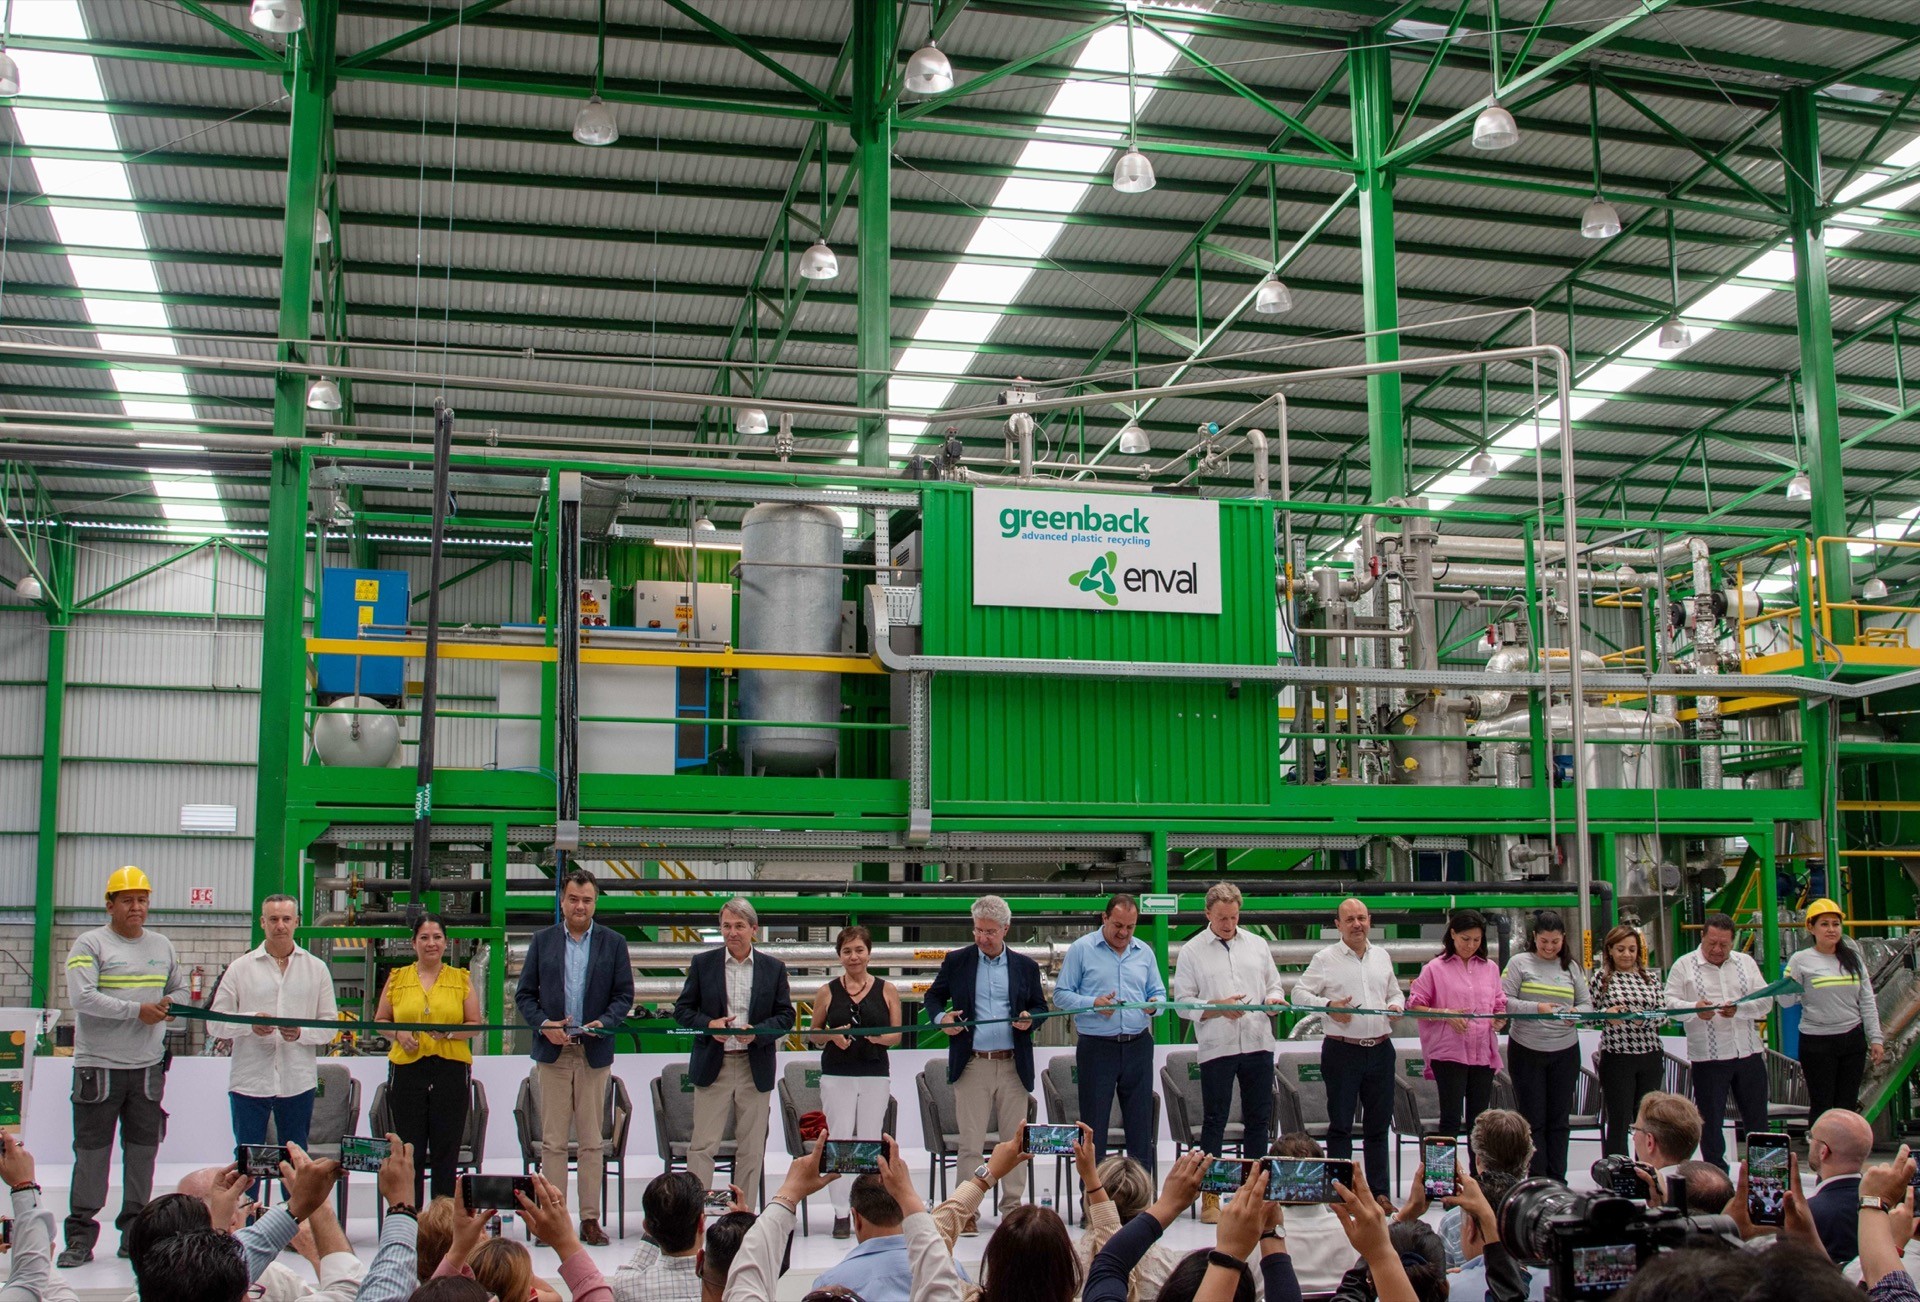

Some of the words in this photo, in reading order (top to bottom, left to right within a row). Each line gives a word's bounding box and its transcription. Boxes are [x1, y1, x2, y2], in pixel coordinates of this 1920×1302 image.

[1000, 504, 1150, 538] greenback
[1021, 531, 1068, 541] advanced
[1071, 533, 1103, 543] plastic
[1107, 535, 1151, 547] recycling
[1123, 562, 1198, 594] enval
[415, 791, 423, 815] AGUA
